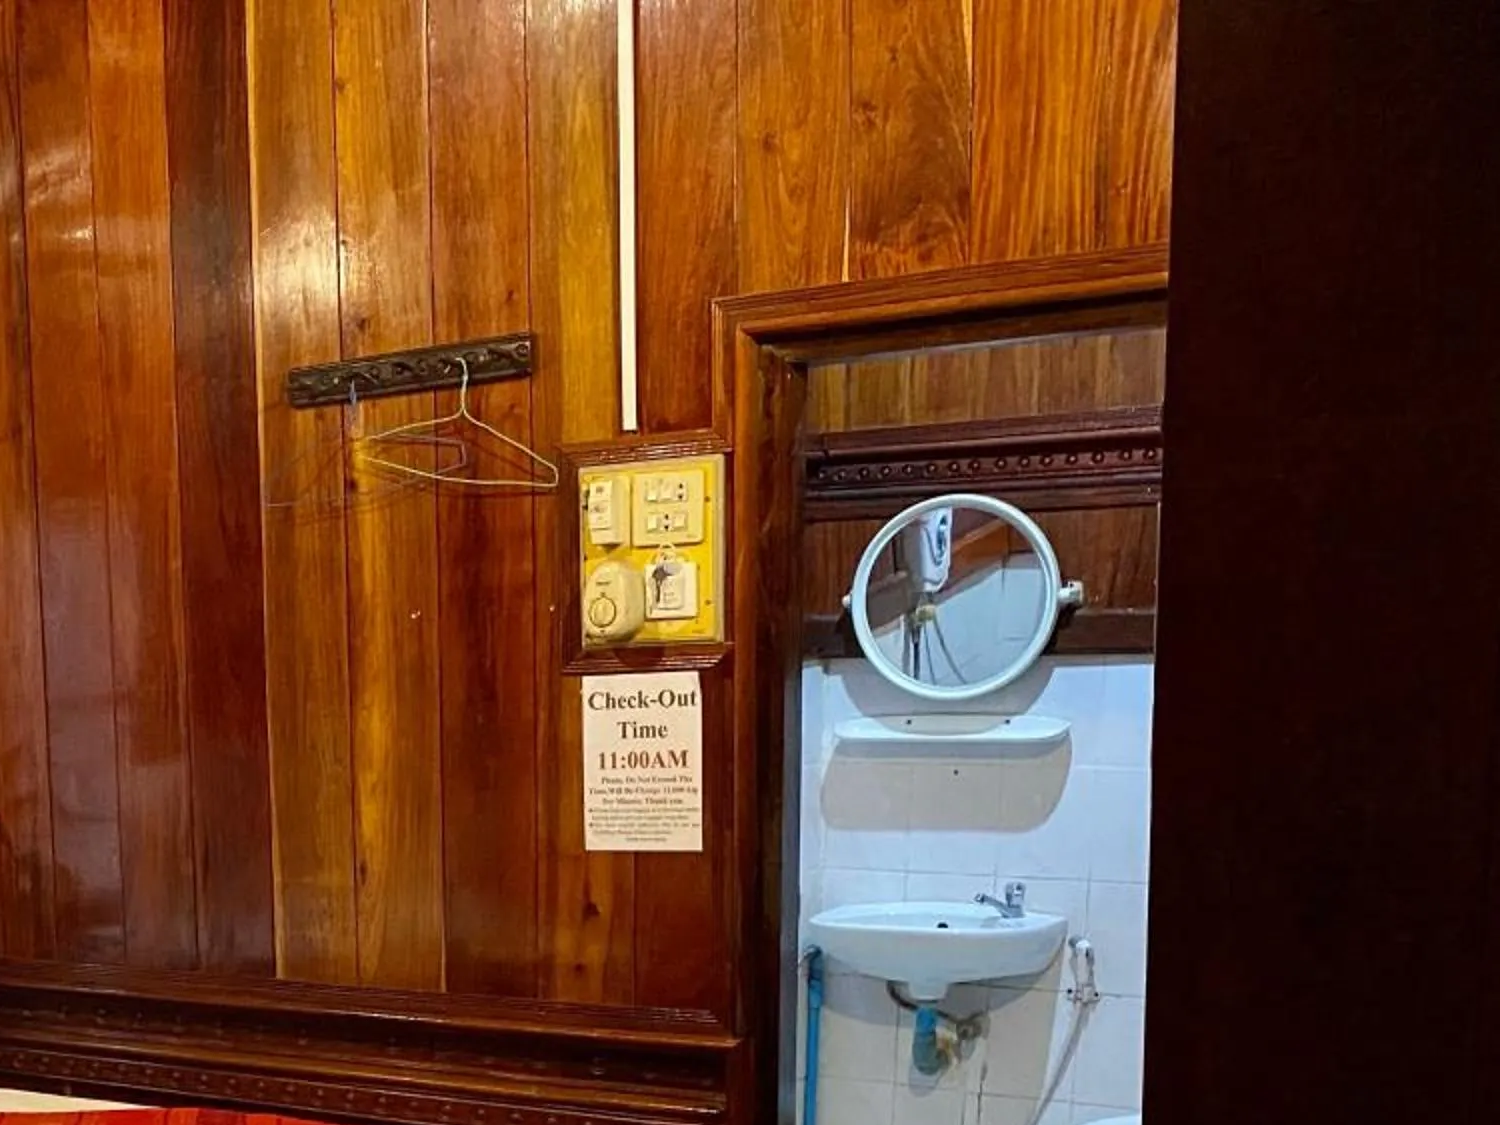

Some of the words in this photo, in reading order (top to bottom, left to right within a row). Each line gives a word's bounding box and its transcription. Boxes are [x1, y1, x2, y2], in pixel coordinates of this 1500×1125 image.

[588, 688, 697, 711] Check-Out
[616, 720, 669, 740] Time
[598, 749, 690, 771] 11:00AM
